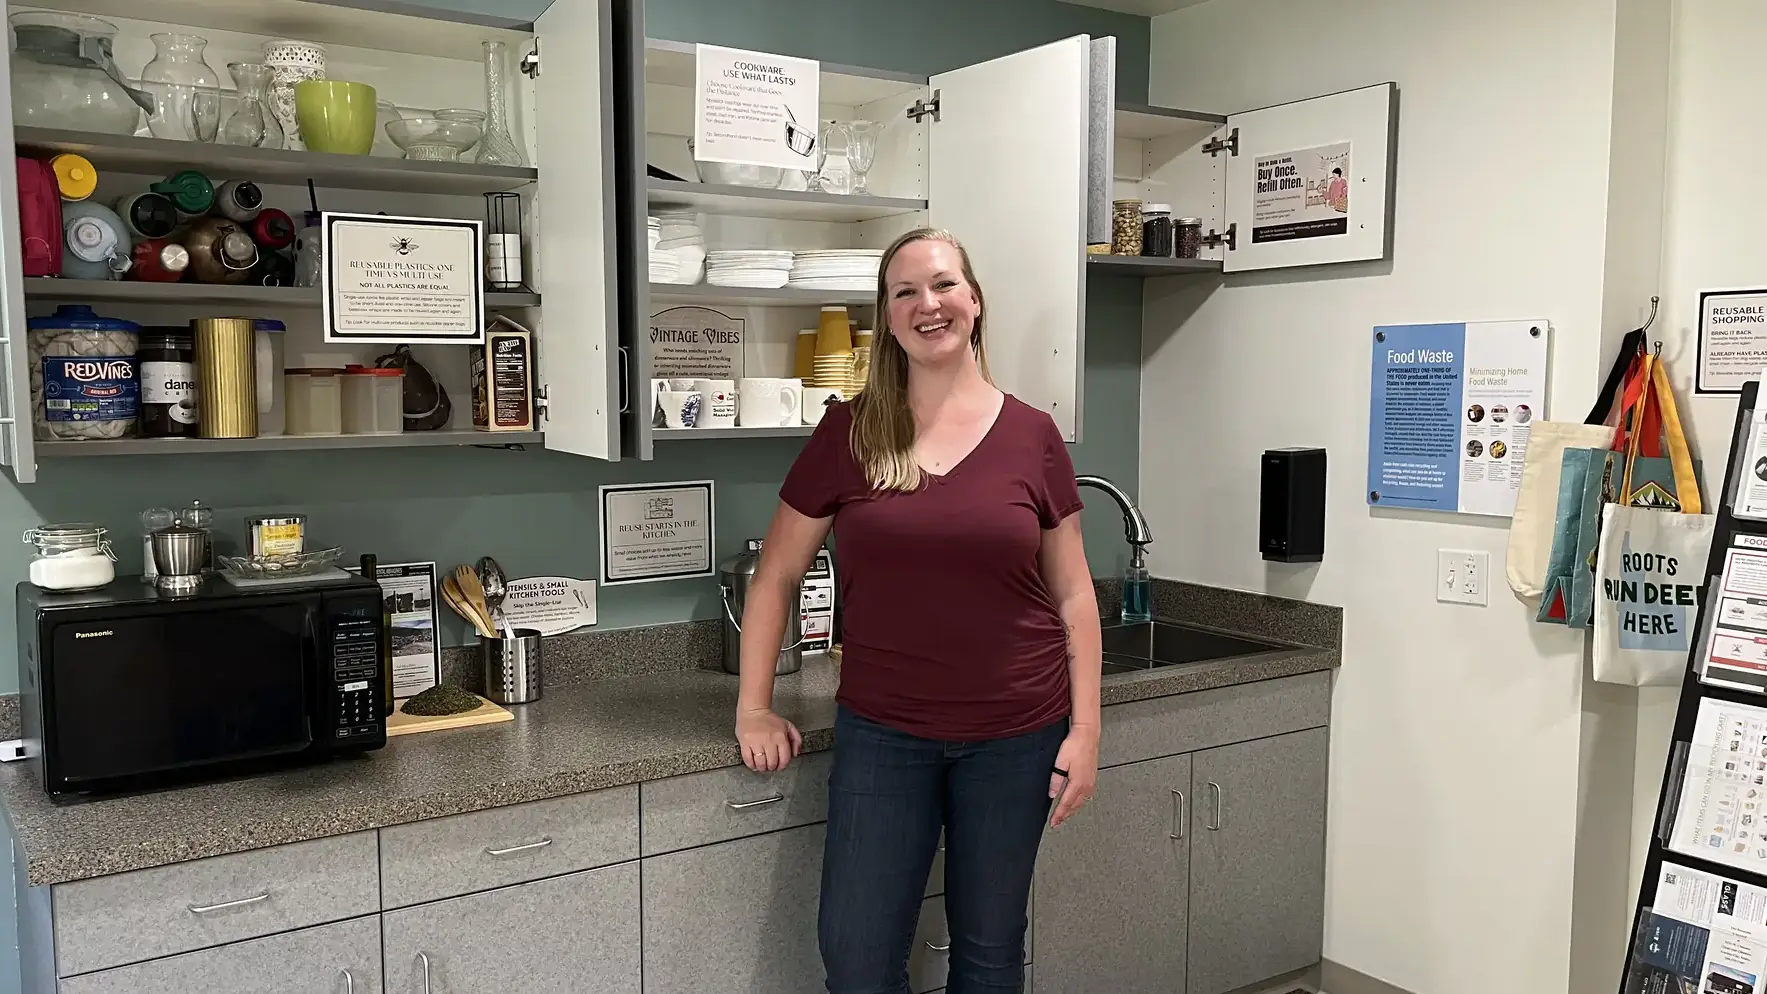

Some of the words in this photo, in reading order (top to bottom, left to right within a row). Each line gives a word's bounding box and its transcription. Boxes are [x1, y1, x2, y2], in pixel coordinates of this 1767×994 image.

[723, 69, 740, 78] USE
[742, 71, 766, 82] WHAT
[768, 75, 796, 85] LASTS!
[1258, 169, 1272, 180] Buy
[1275, 165, 1297, 178] Once.
[1257, 180, 1278, 193] Refill
[1280, 178, 1303, 190] Often.
[350, 261, 393, 269] REUSABLE
[1712, 306, 1764, 315] REUSABLE
[1712, 315, 1764, 324] SHOPPING
[650, 327, 698, 344] VINTAGE
[703, 328, 740, 344] VIBES
[1388, 349, 1415, 364] Food
[1418, 349, 1453, 363] Waste
[619, 524, 644, 532] REUSE
[646, 522, 673, 530] STARTS
[642, 530, 676, 539] KITCHEN
[1623, 553, 1678, 576] ROOTS
[509, 591, 539, 599] KITCHEN
[1604, 578, 1637, 603] RUN
[1624, 611, 1678, 635] HERE
[76, 630, 113, 638] Panasonic
